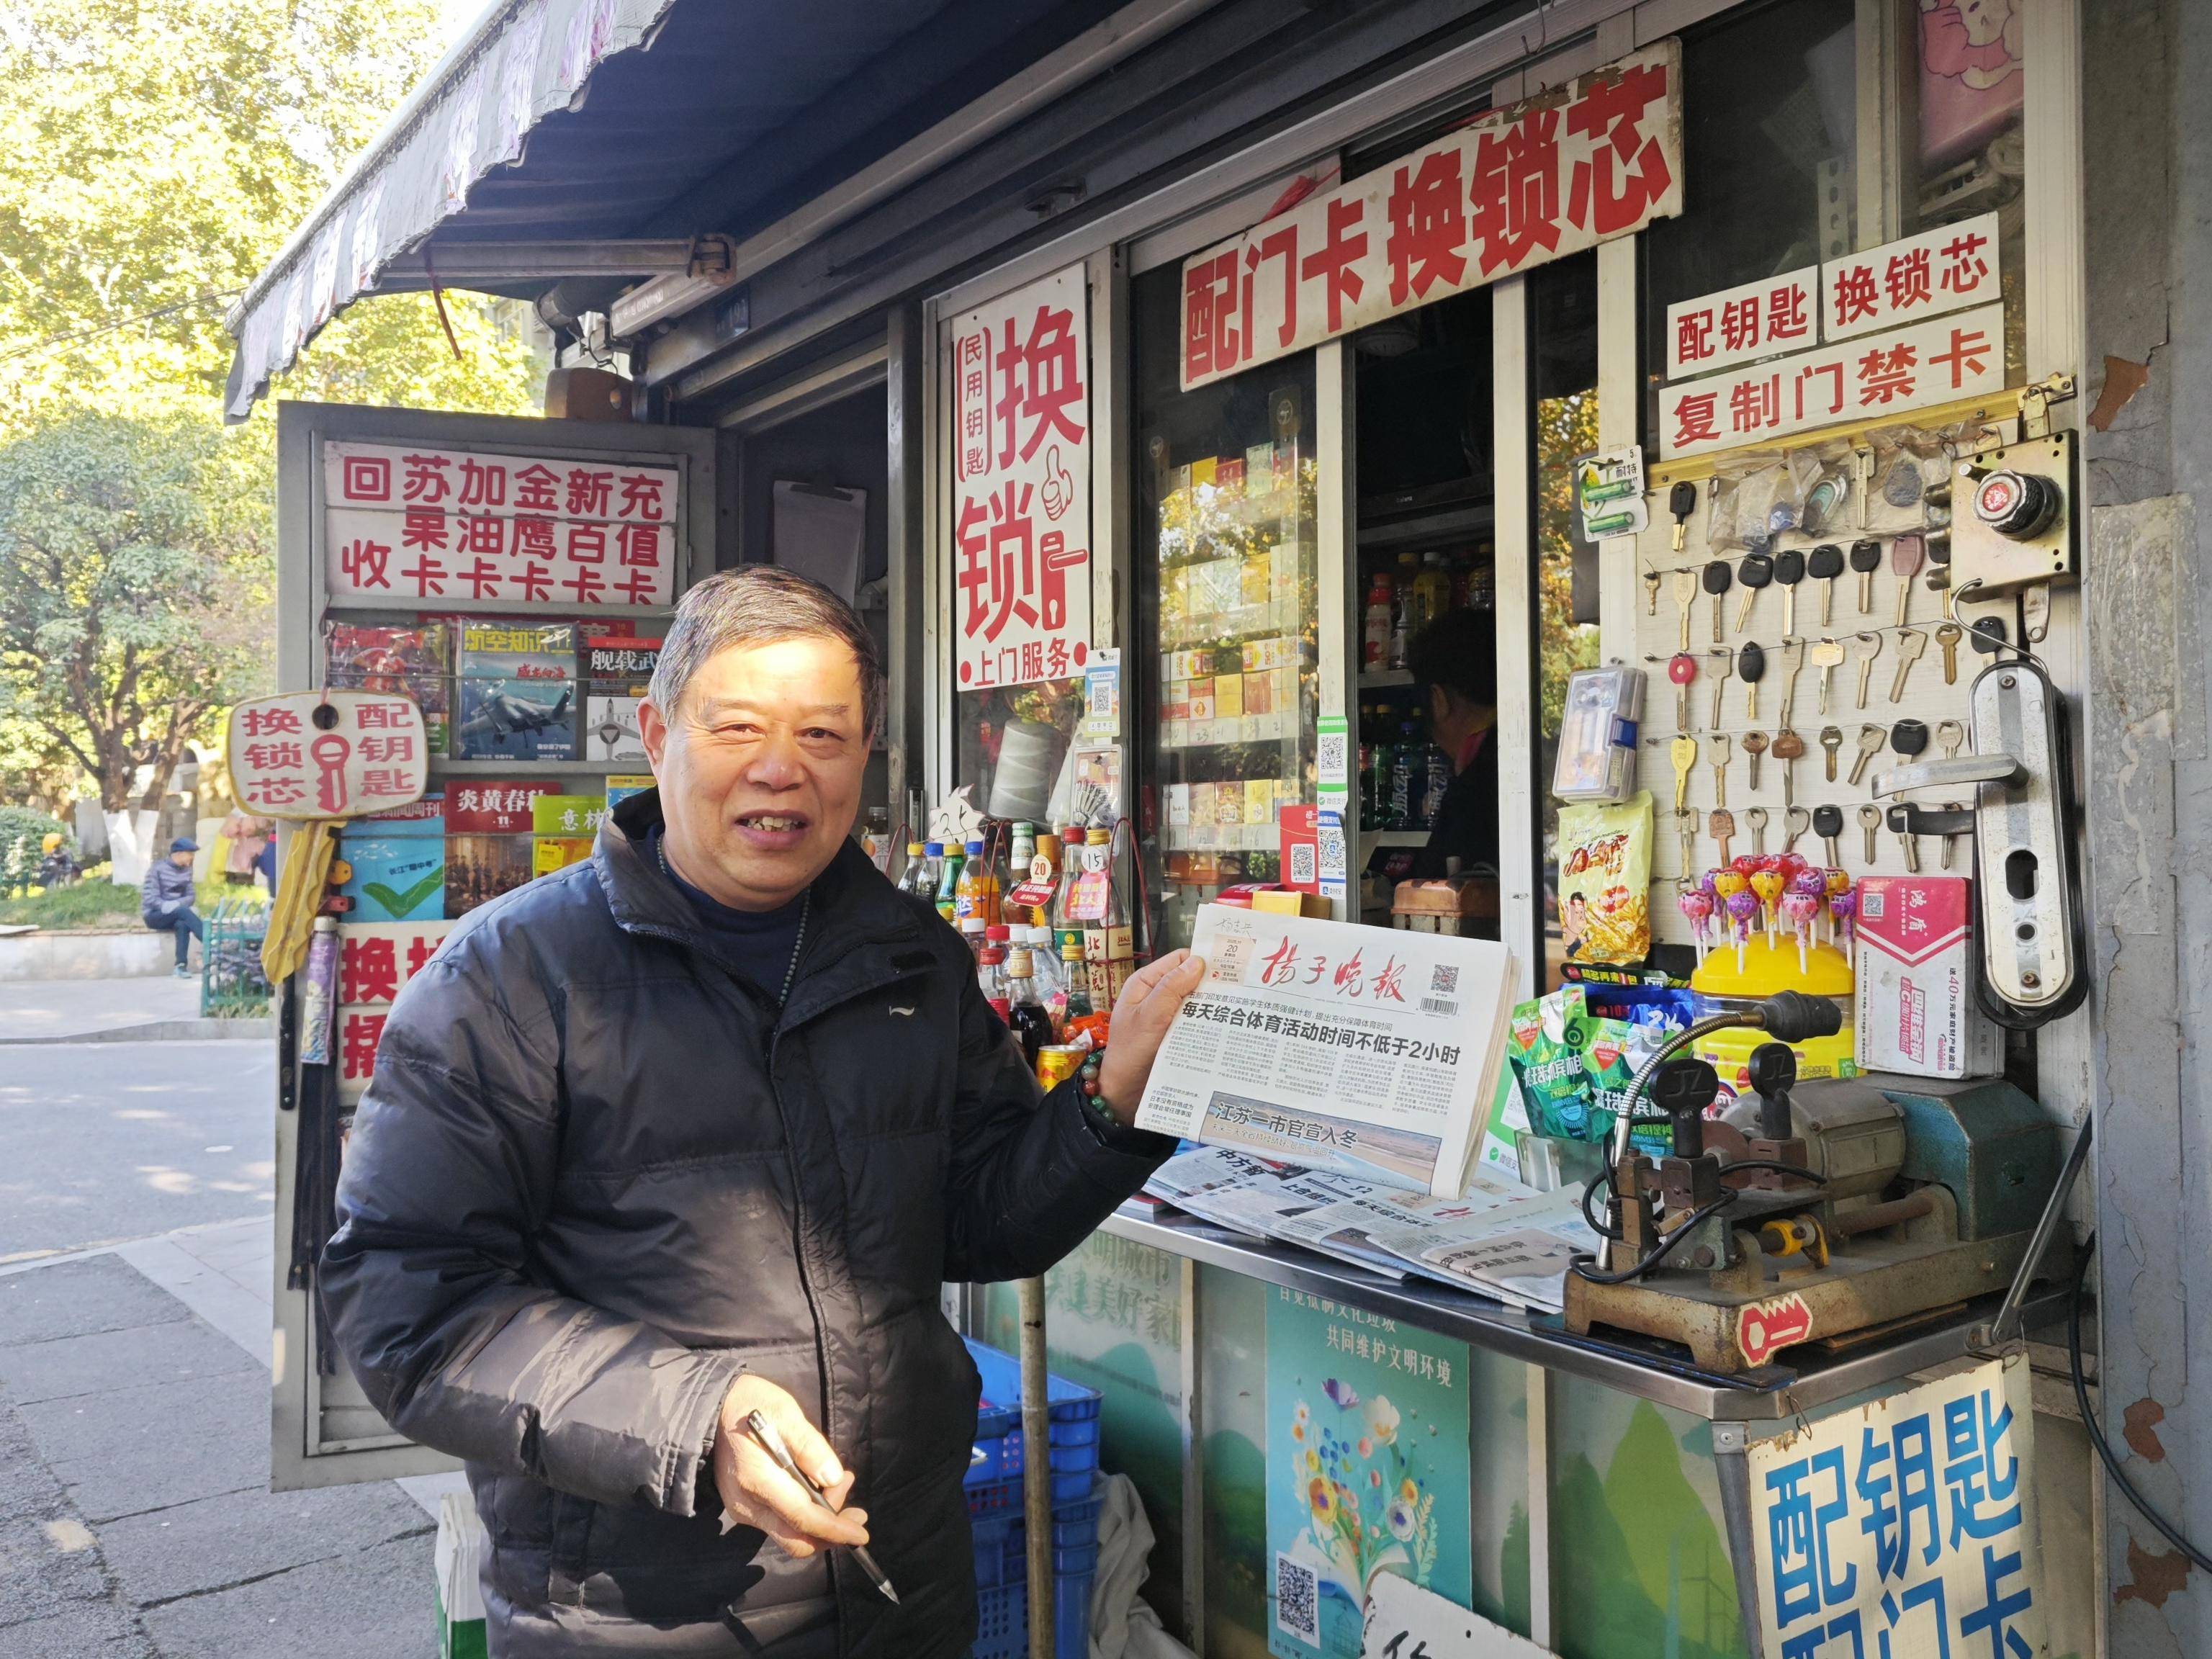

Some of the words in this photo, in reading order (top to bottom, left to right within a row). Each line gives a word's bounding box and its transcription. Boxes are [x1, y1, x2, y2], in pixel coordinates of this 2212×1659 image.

[1185, 63, 1672, 384] 配门卡换锁芯
[1677, 283, 1808, 364] 配钥匙
[1833, 233, 1989, 326] 换锁芯
[1672, 328, 1992, 449] 复制门禁卡
[342, 456, 392, 588] 回收
[956, 305, 1086, 644] 换锁
[401, 454, 451, 597] 苏果卡
[457, 458, 506, 599] 加油卡
[510, 464, 562, 602] 金鹰卡
[562, 469, 613, 603] 新百卡
[614, 474, 664, 605] 充值卡
[974, 637, 1070, 687] 上门服务
[241, 708, 306, 805] 换锁芯
[354, 703, 416, 797] 配钥匙
[1035, 862, 1046, 876] 20
[1088, 853, 1102, 870] 15
[1226, 944, 1238, 953] 20
[1182, 1001, 1461, 1066] 每天综合体育活动时间不低于2小时
[1215, 1102, 1358, 1150] 江苏一市官宣入冬
[1326, 1323, 1452, 1388] 共同维护文明环境
[1766, 1388, 2022, 1630] 配钥匙
